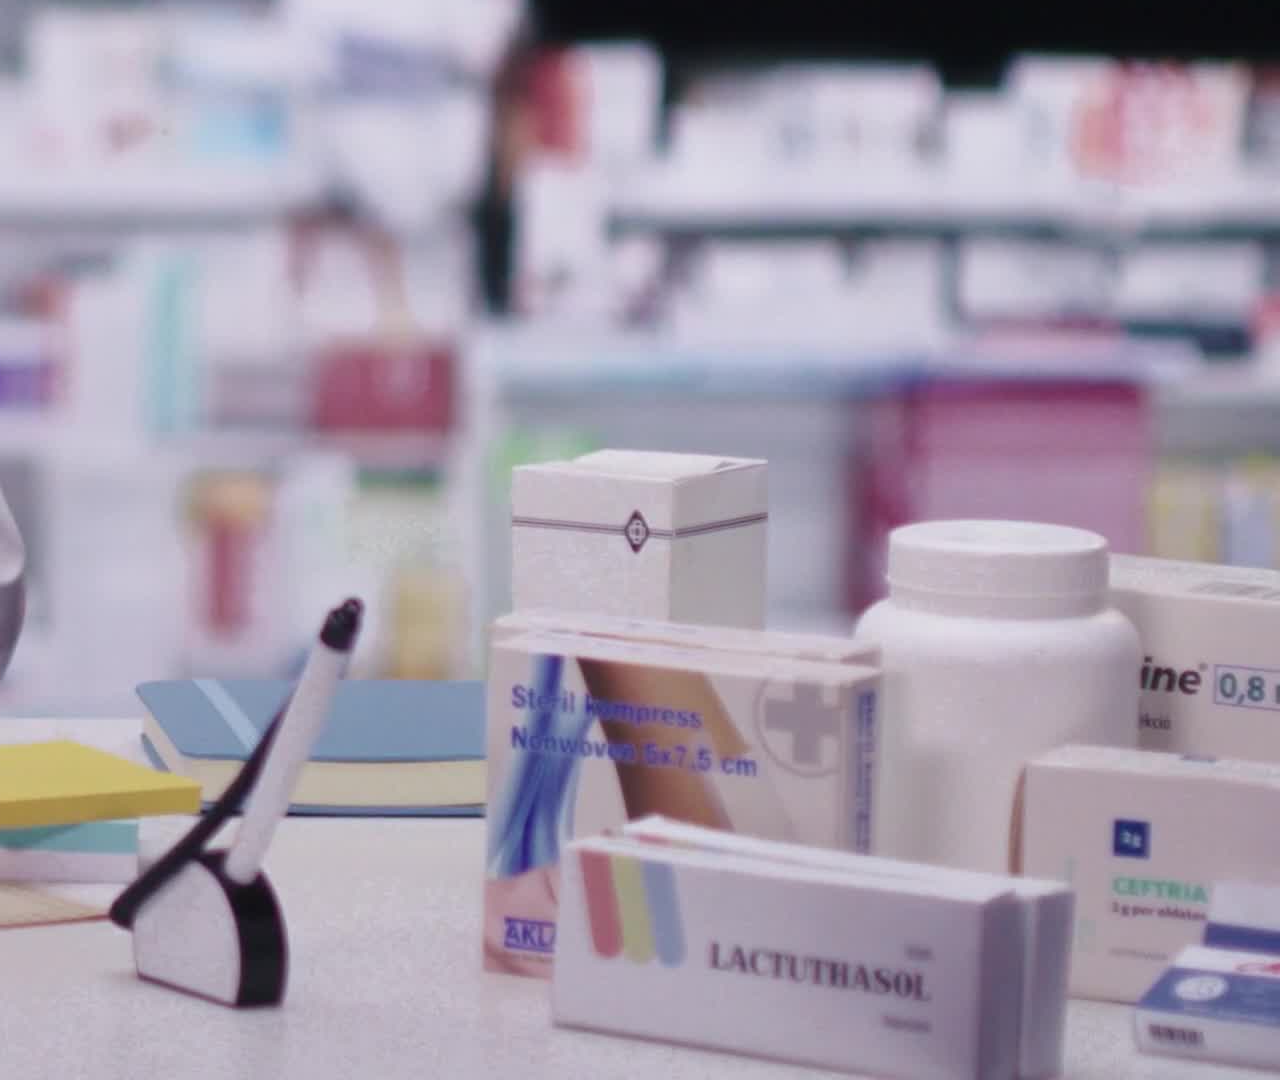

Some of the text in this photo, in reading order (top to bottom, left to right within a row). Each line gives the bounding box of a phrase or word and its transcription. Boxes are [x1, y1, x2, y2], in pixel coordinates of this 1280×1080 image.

[511, 683, 576, 713] Steril
[1218, 672, 1265, 705] 0,8
[511, 724, 636, 762] Nonwoven
[720, 756, 758, 777] cm
[708, 940, 932, 1002] LACTUTHASOL
